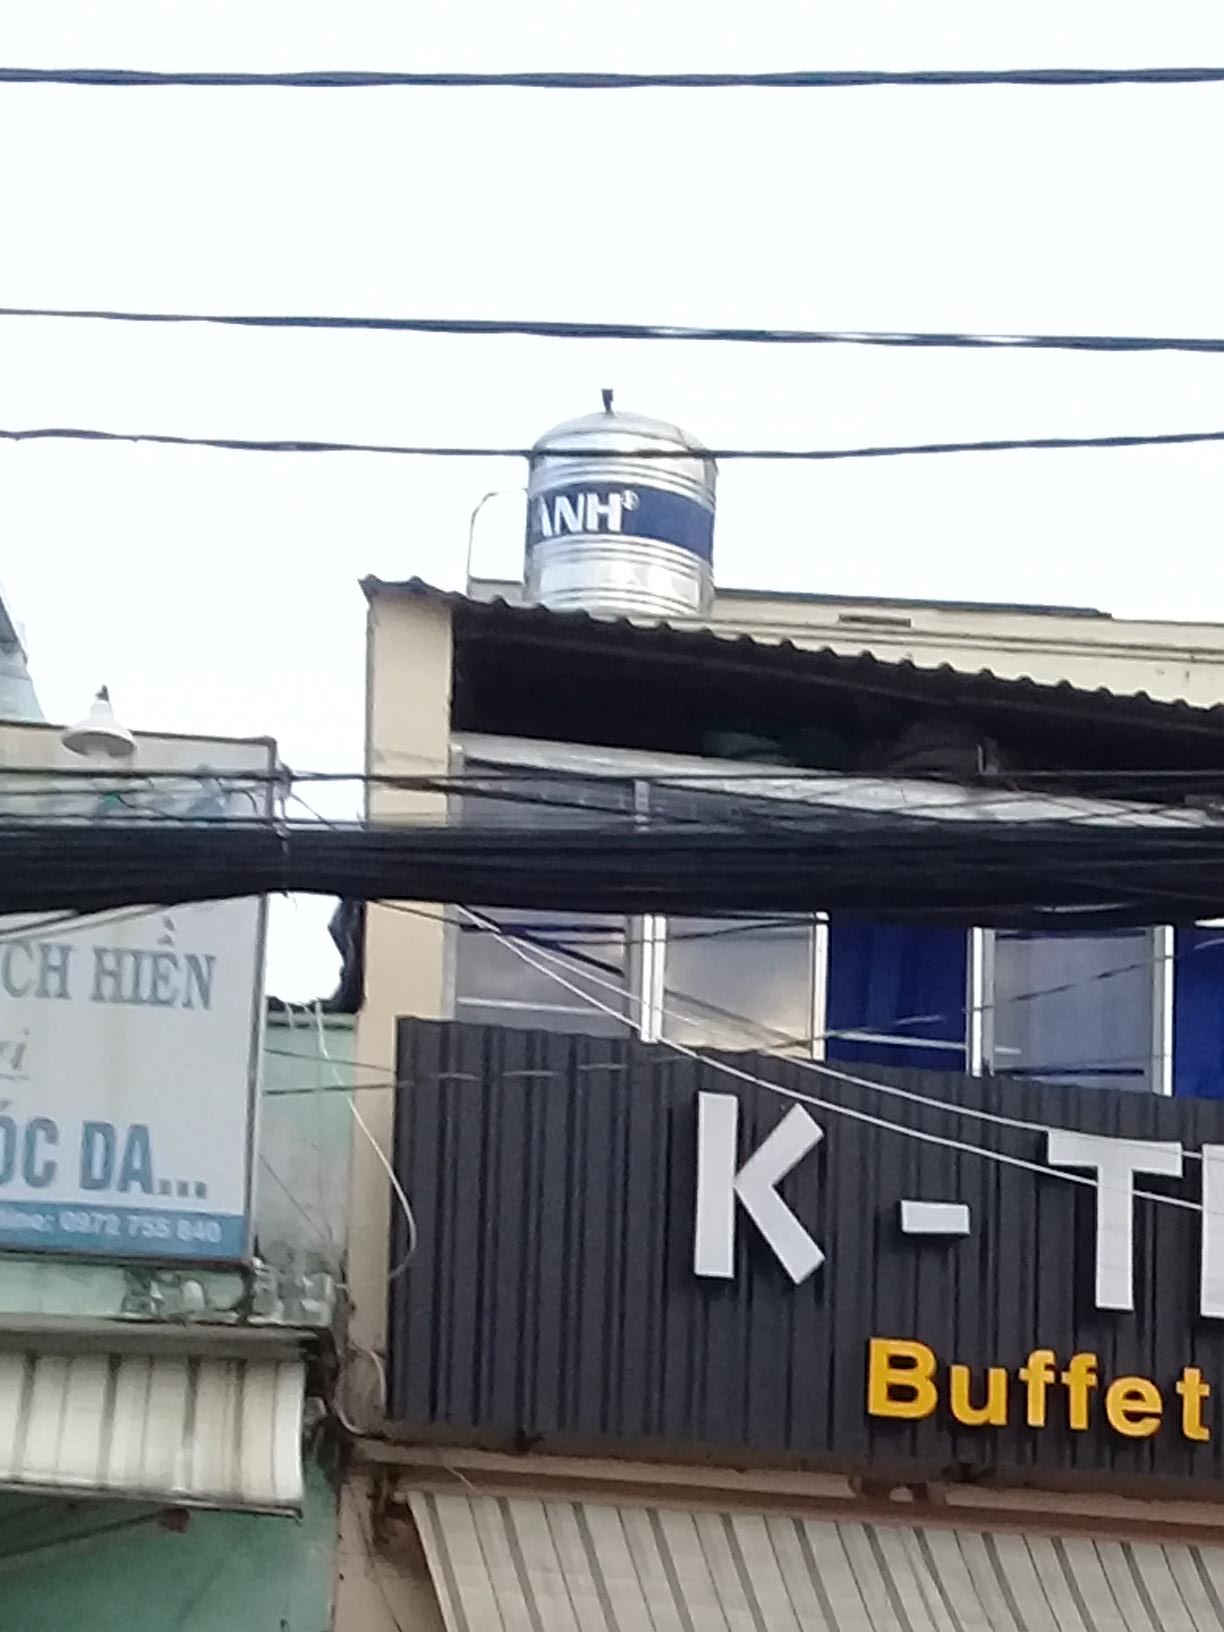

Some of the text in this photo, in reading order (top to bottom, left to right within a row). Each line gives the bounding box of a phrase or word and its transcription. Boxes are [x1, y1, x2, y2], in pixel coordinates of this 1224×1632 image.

[90, 917, 215, 1010] HIỀN
[694, 1091, 826, 1284] K
[866, 1337, 1211, 1442] Buffet
